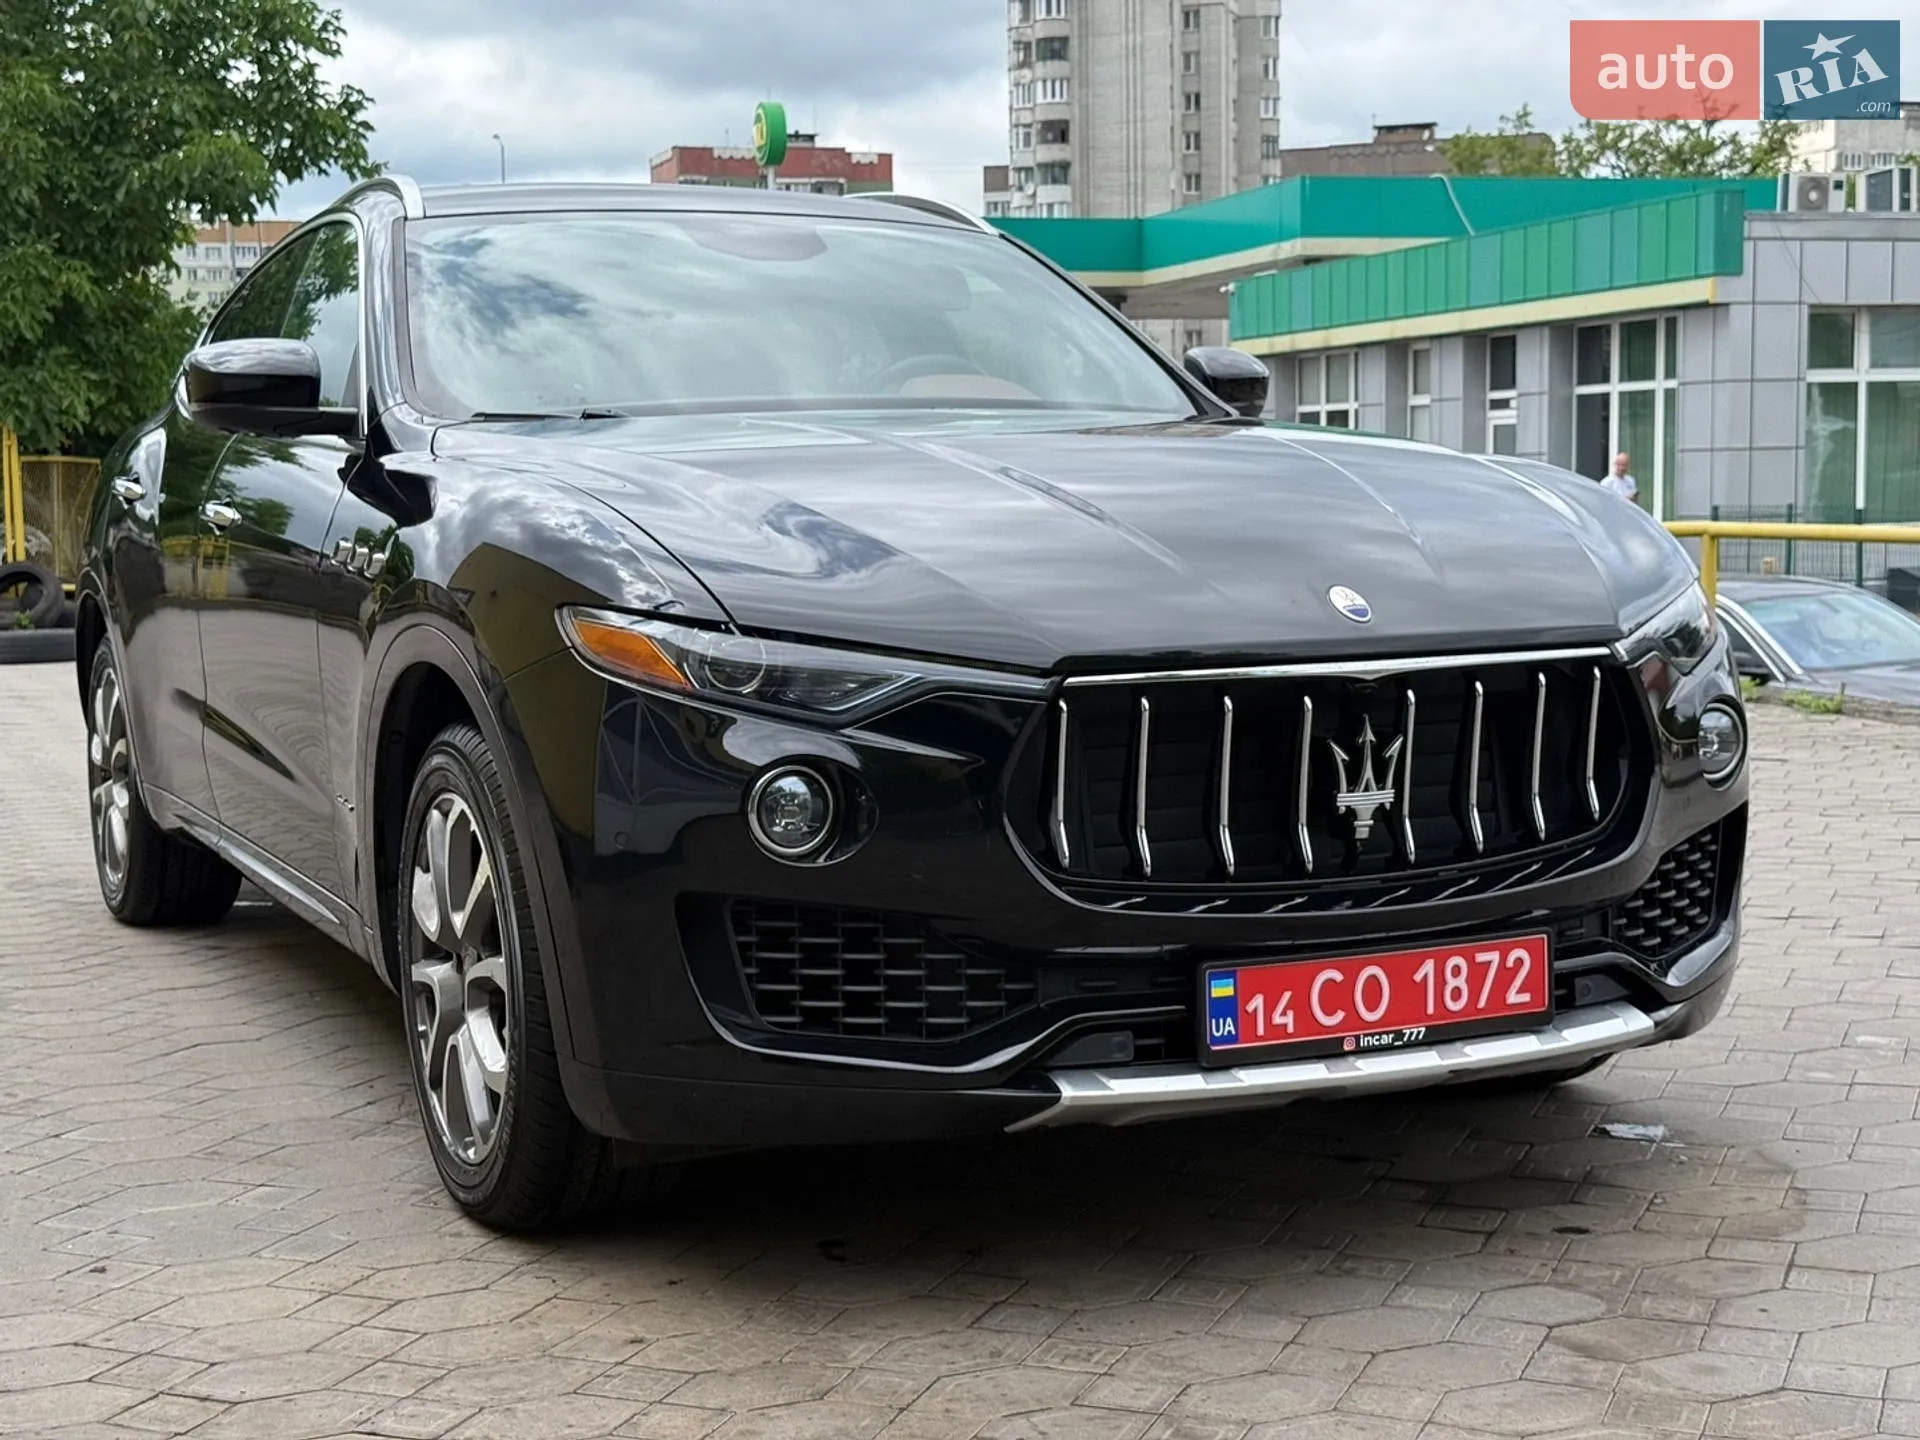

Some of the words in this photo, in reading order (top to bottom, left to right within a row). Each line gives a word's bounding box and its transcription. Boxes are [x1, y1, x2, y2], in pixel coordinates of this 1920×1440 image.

[1245, 991, 1295, 1037] 14
[1309, 965, 1391, 1027] CO
[1412, 948, 1532, 1016] 1872
[1211, 1017, 1236, 1038] UA
[1359, 1027, 1426, 1048] incar_777
